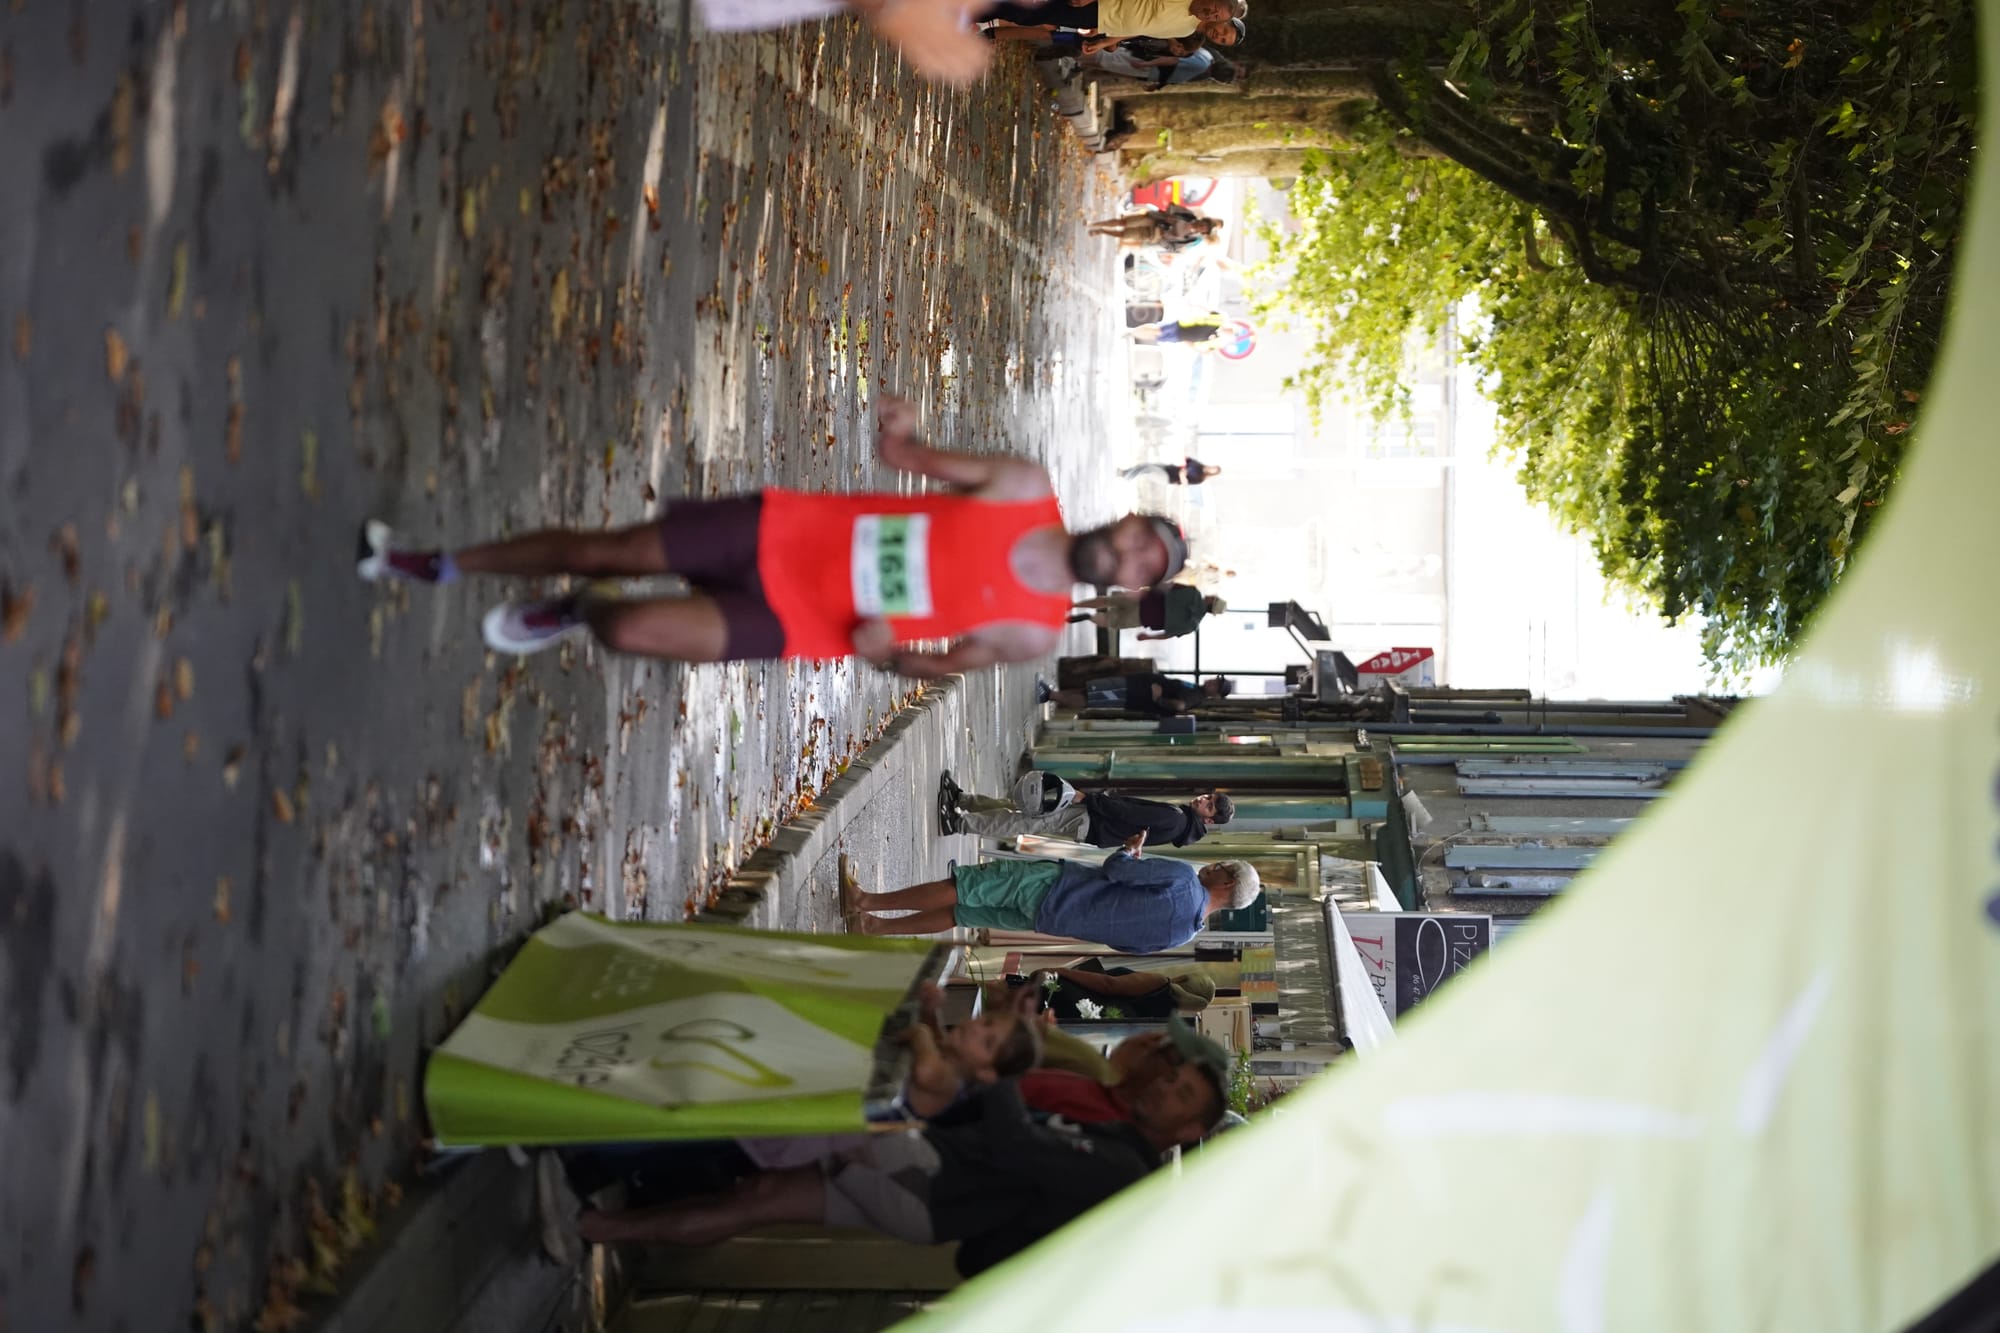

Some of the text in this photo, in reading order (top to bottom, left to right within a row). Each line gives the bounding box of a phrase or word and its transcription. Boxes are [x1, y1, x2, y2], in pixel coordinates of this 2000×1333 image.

[879, 531, 907, 601] 165
[1370, 650, 1420, 669] TABAC
[1384, 959, 1394, 972] Le
[1452, 924, 1478, 982] Pizz
